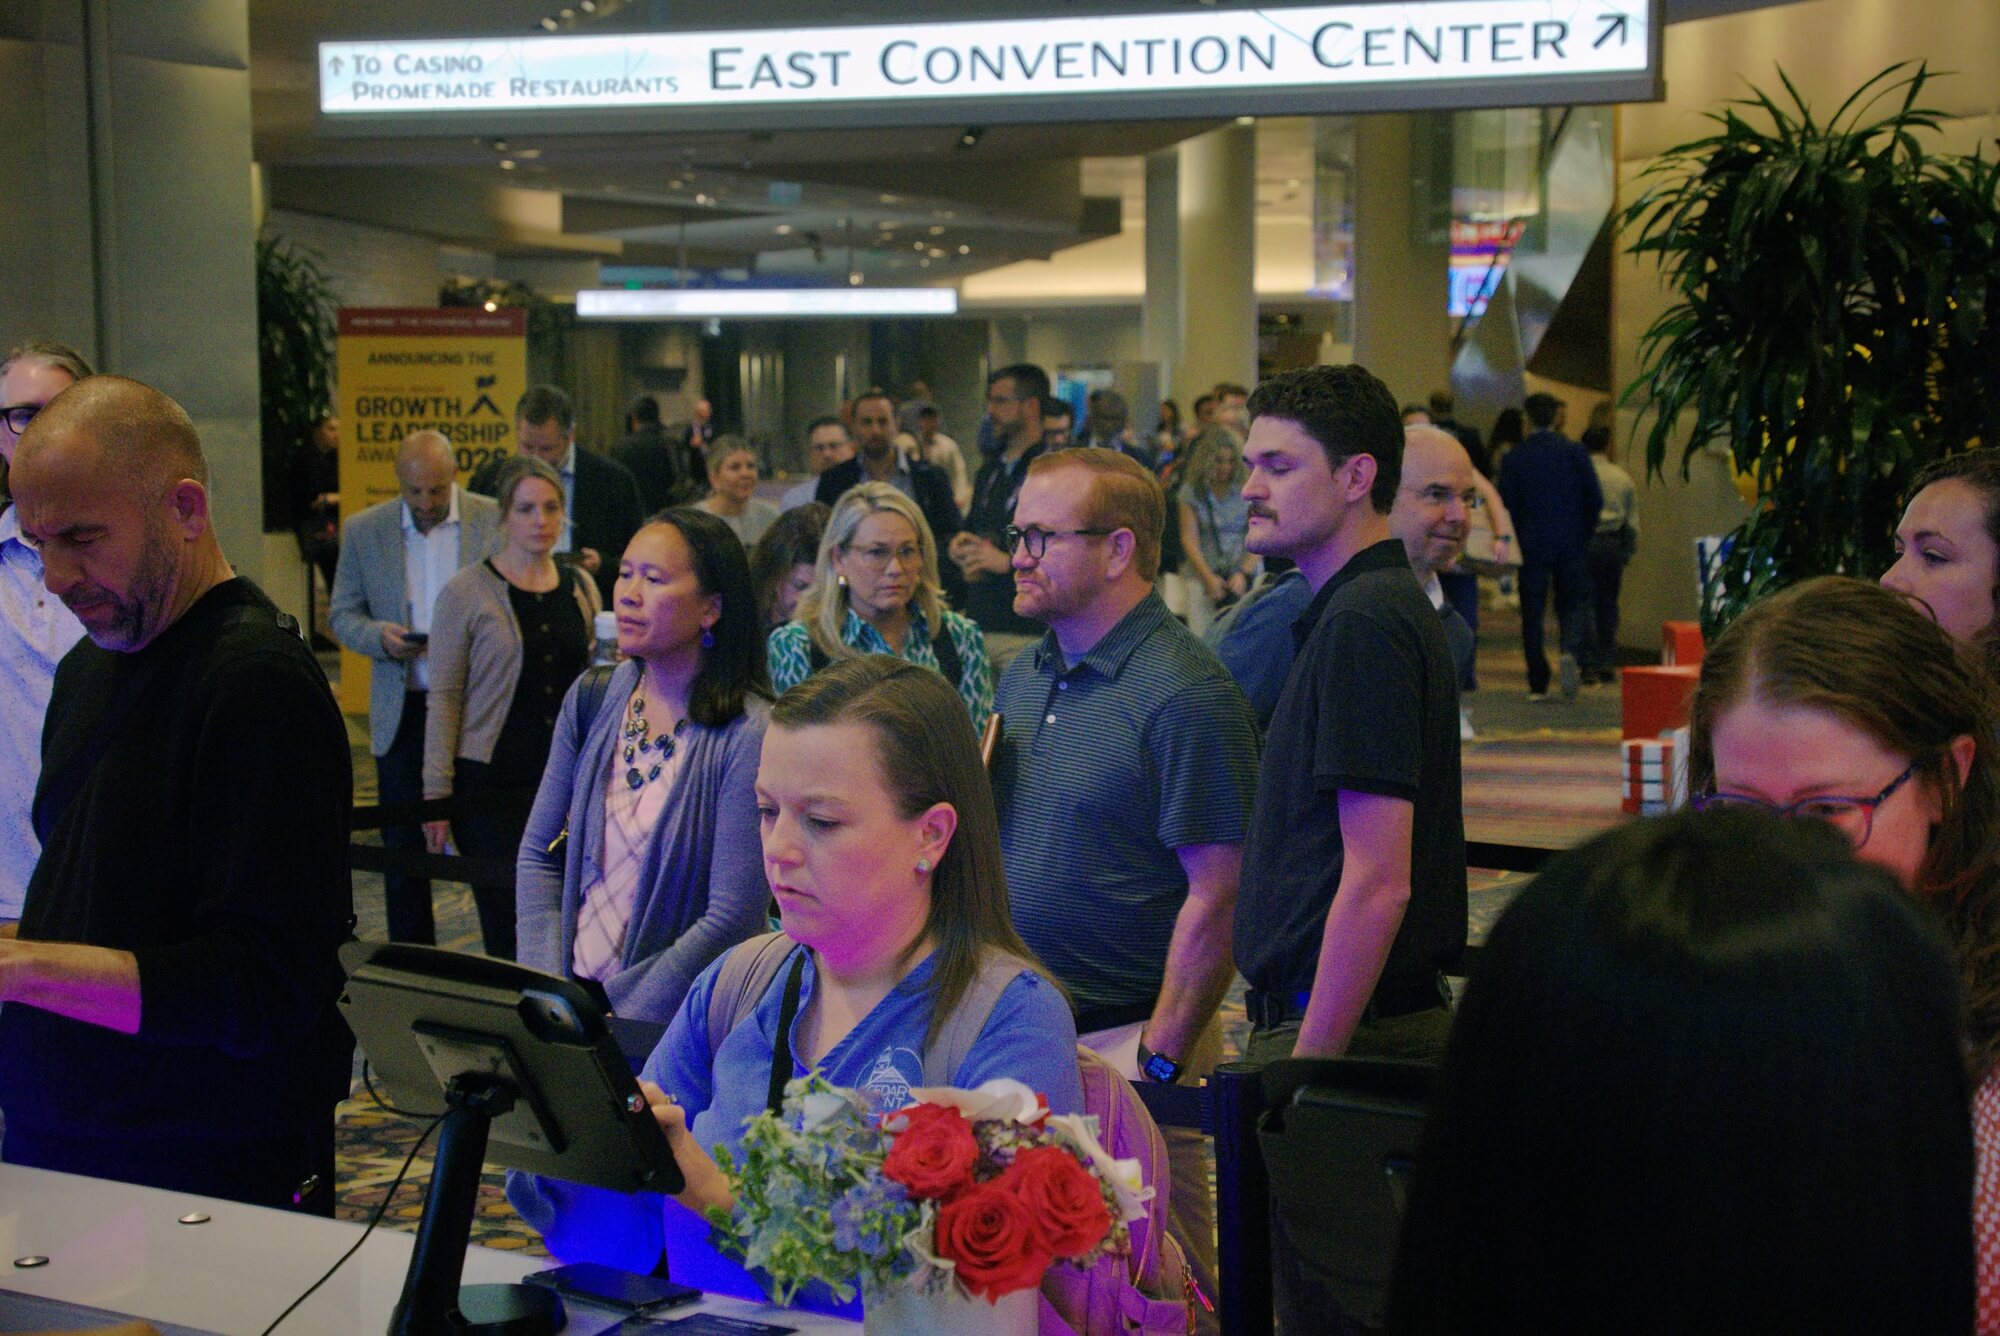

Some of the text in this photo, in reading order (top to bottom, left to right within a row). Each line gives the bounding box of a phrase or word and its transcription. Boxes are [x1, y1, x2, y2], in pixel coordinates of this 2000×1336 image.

[351, 53, 484, 76] TO CASINO
[708, 19, 1571, 90] EAST CONVENTION CENTER
[352, 75, 679, 101] PROMENADE RESTAURANTS
[367, 352, 495, 366] ANNOUNCING THE
[355, 396, 462, 418] GROWTH
